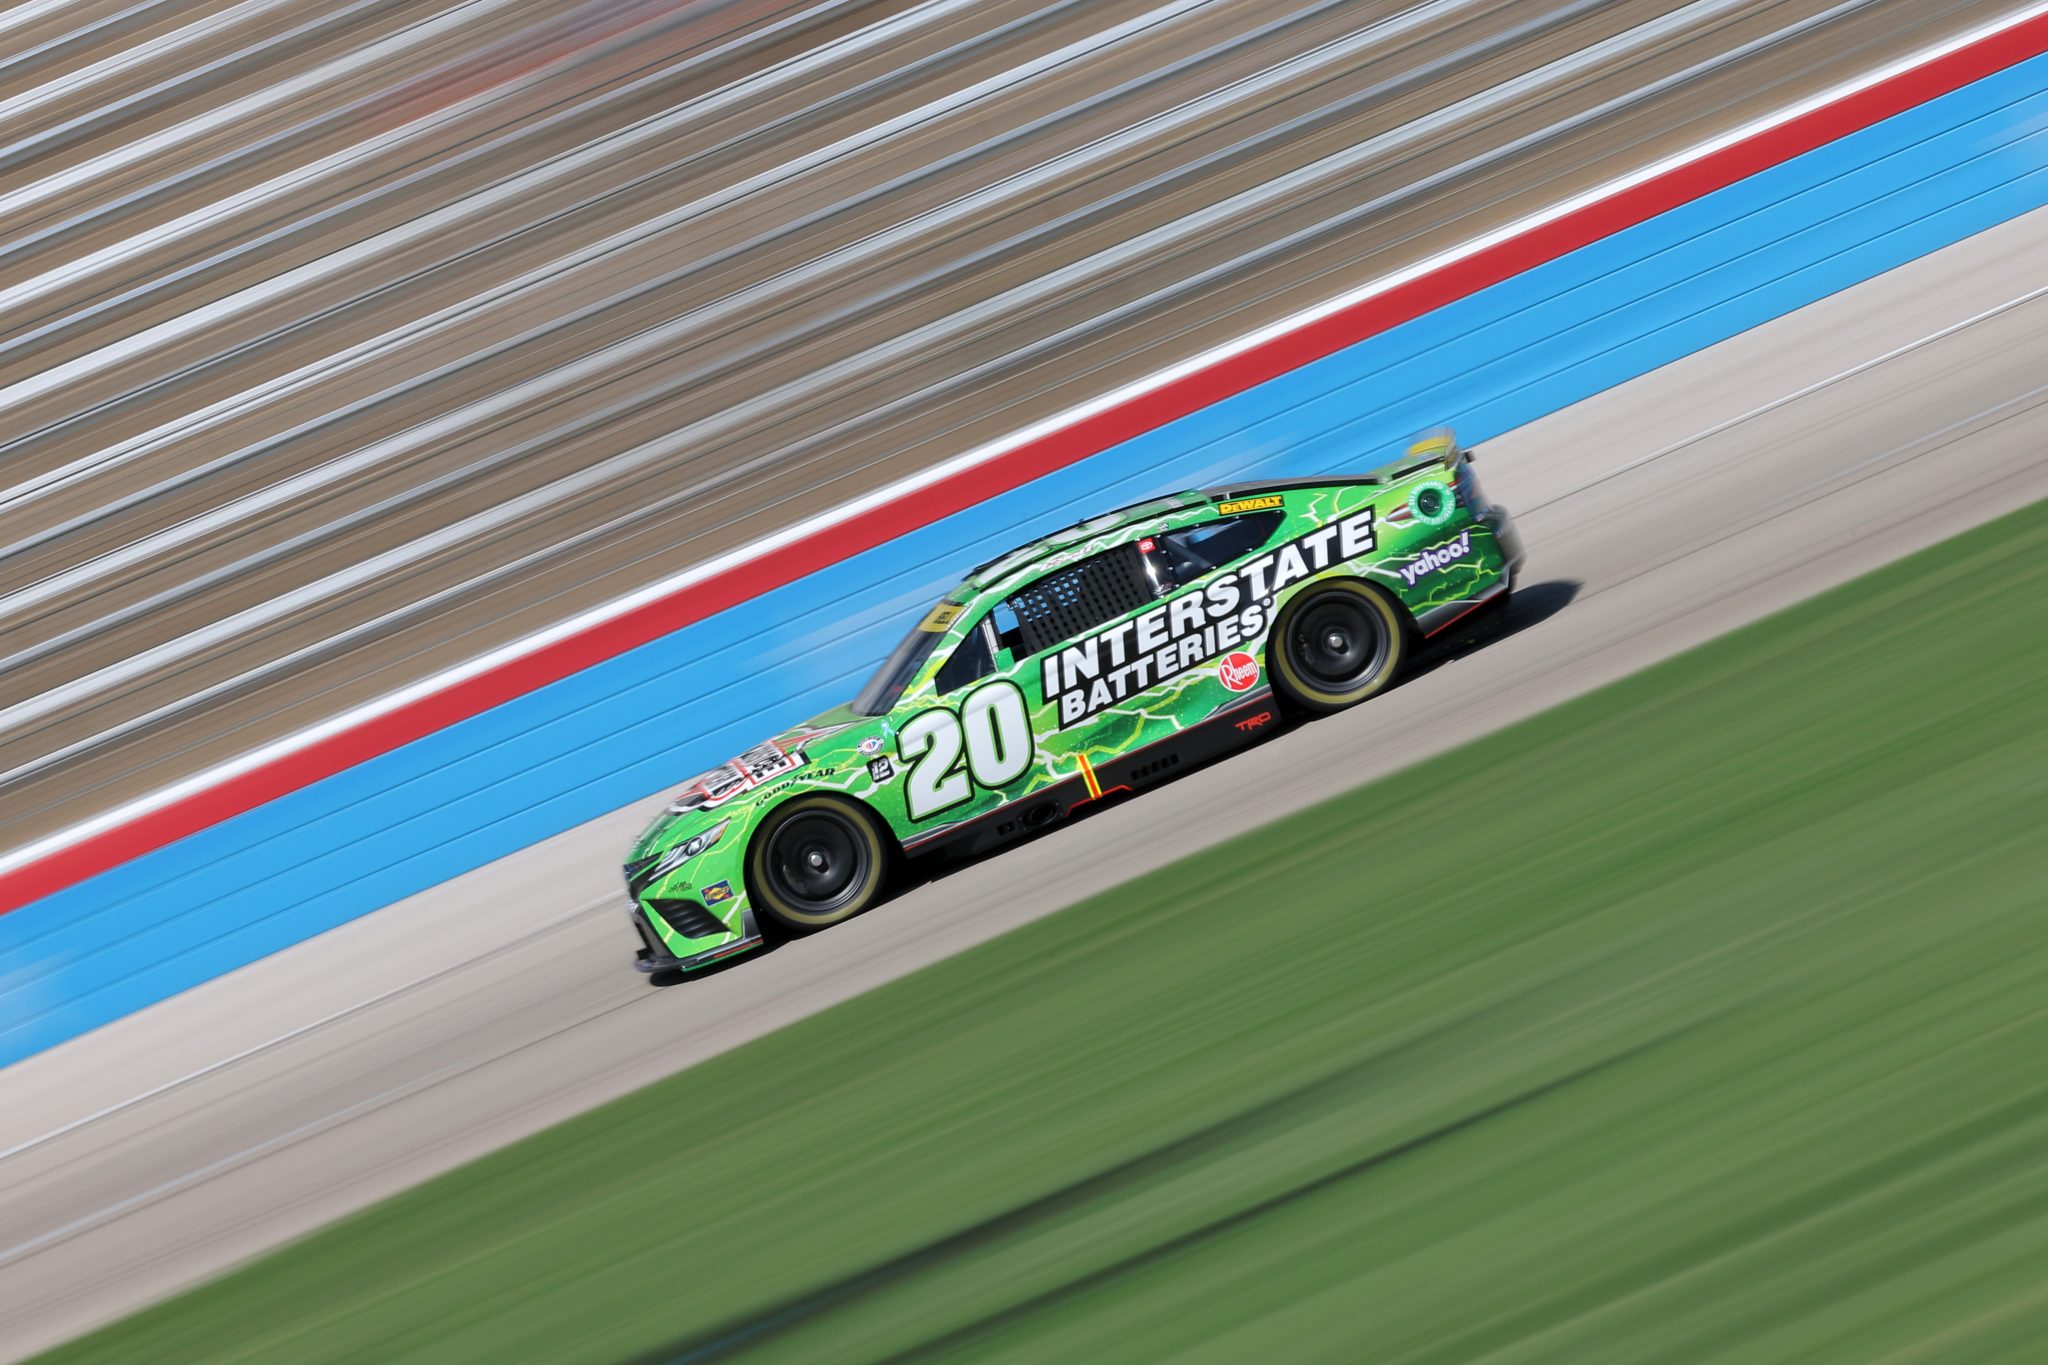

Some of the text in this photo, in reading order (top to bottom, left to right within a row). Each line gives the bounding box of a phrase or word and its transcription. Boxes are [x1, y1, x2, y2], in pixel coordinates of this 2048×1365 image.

[1400, 531, 1470, 586] yahoo!
[1045, 510, 1374, 698] INTERSTATE
[1062, 607, 1264, 724] BATTERIES
[1221, 656, 1258, 689] Rheem
[755, 768, 836, 807] GOODYEAR
[900, 682, 1033, 821] 20
